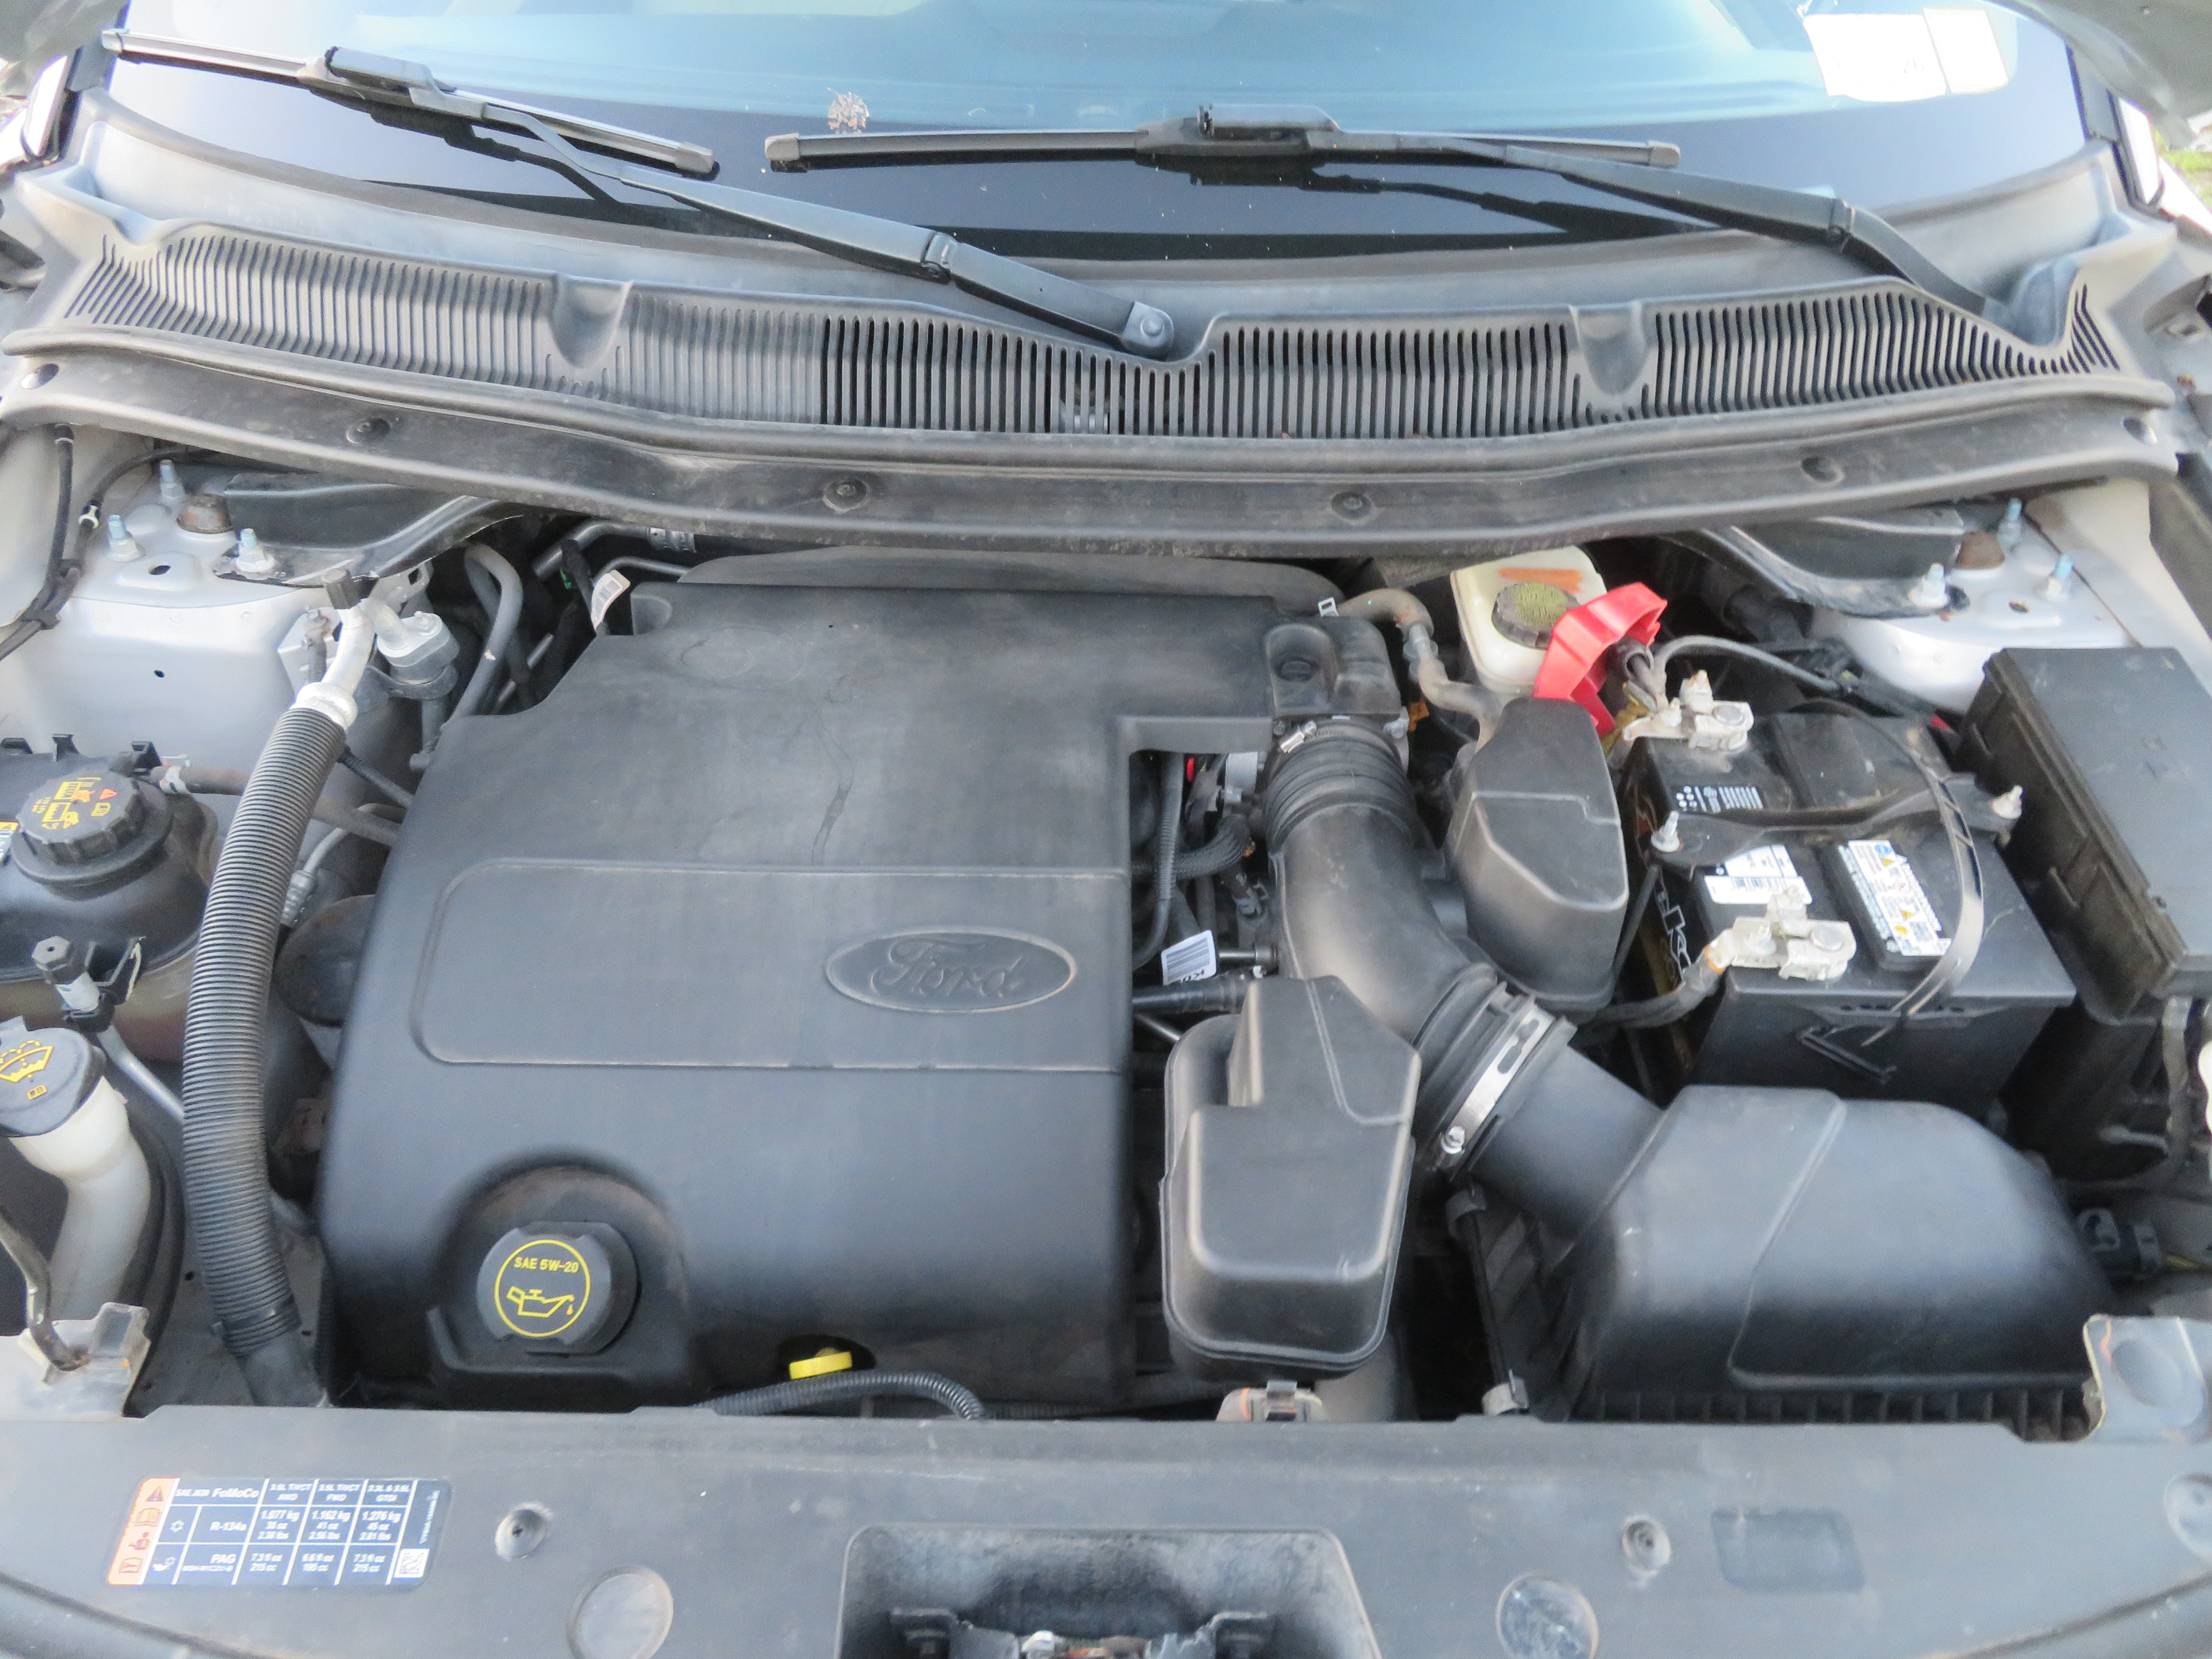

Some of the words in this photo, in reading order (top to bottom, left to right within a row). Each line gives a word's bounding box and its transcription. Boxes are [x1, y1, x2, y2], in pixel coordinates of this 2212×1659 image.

[870, 938, 1028, 998] Ford
[514, 1257, 538, 1270] SAE
[540, 1259, 579, 1273] 5W-20
[212, 1488, 259, 1498] FoMoCo
[337, 1510, 352, 1522] kg
[387, 1511, 402, 1523] kg
[210, 1521, 247, 1531] R-134a
[210, 1554, 236, 1564] PAG
